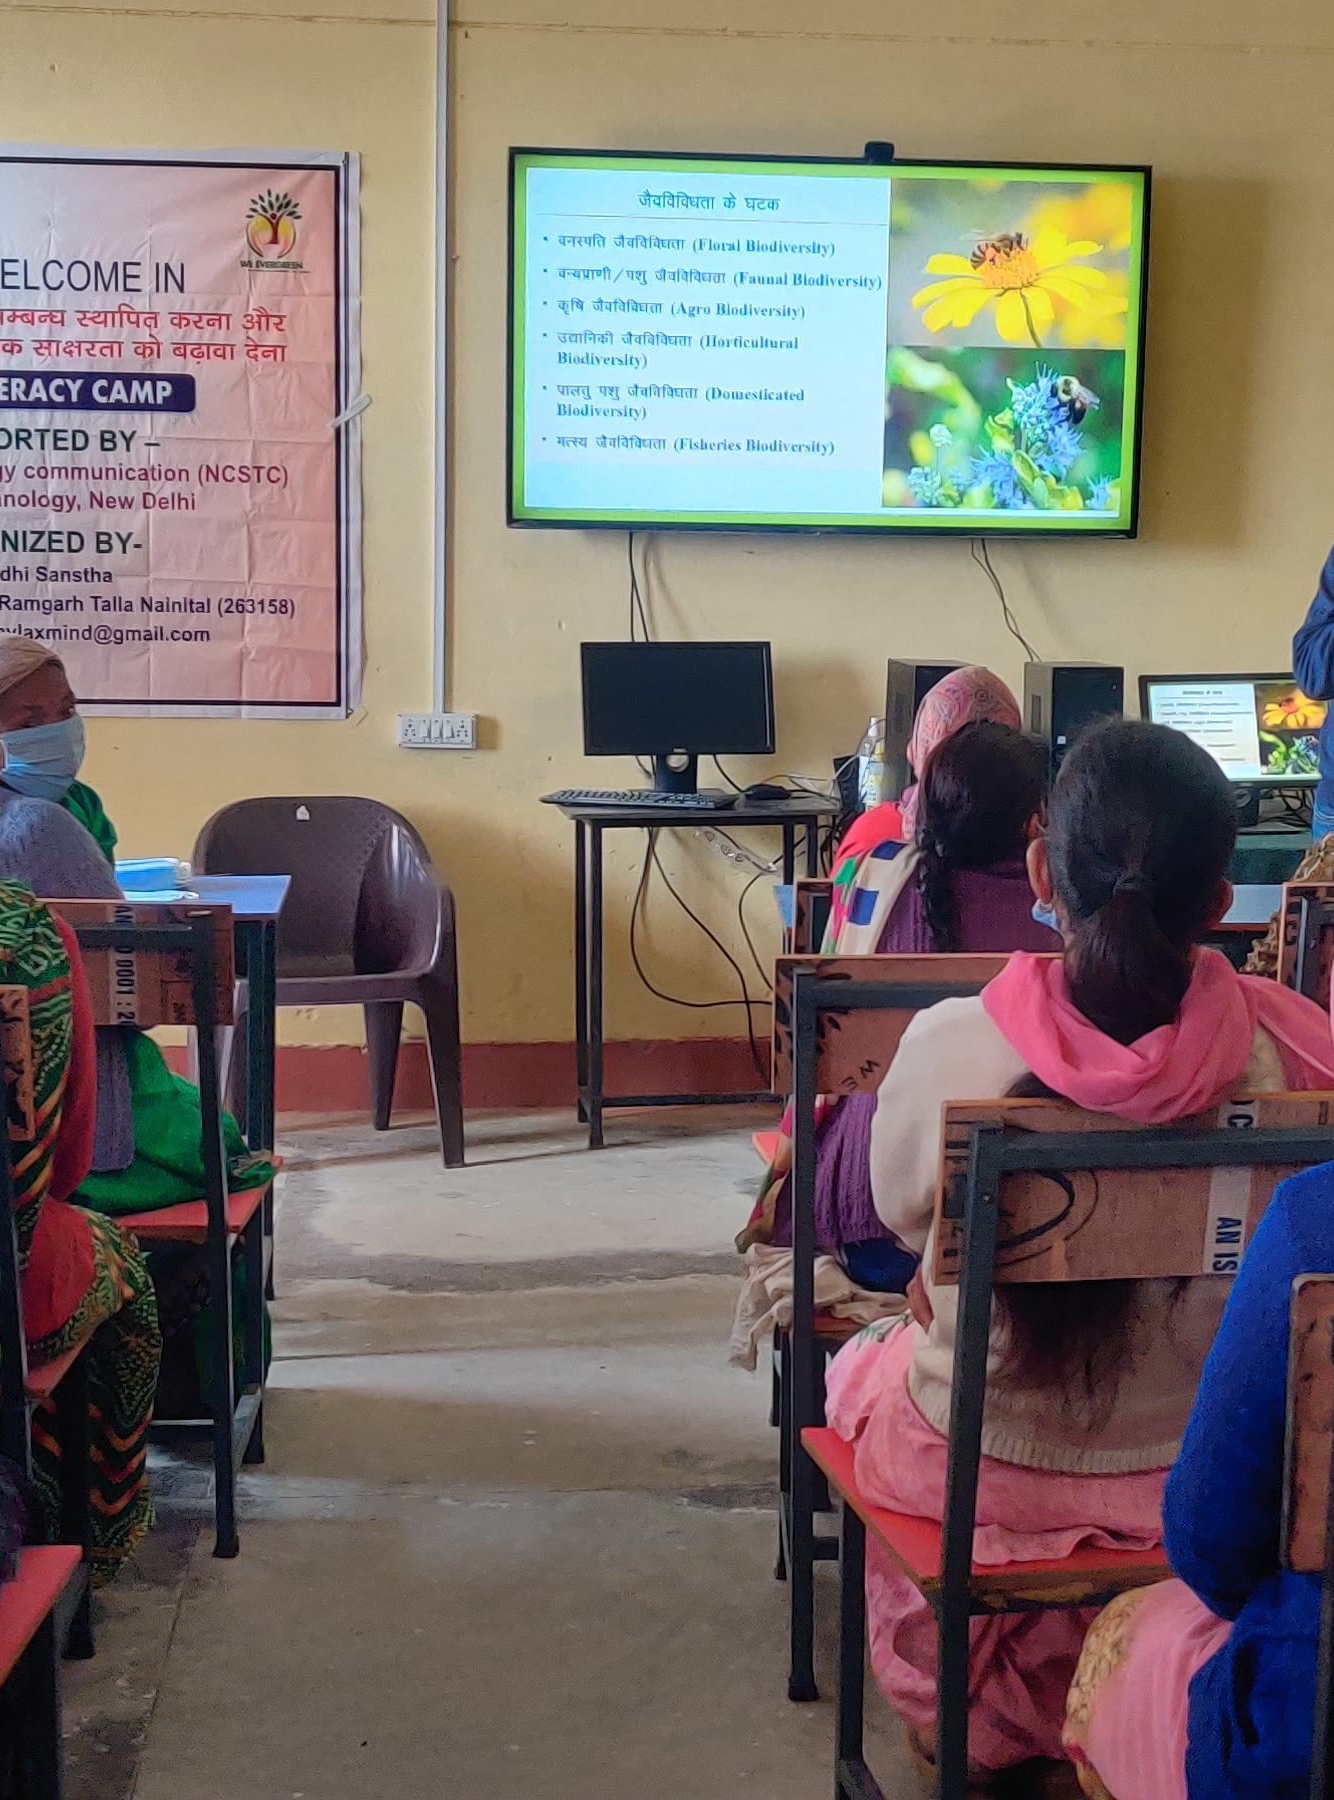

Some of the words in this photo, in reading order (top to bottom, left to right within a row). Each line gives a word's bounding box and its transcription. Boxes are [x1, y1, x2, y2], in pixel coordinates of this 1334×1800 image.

[638, 189, 715, 211] जैवविविधता
[722, 191, 737, 211] के
[744, 197, 781, 212] घटक
[557, 234, 606, 250] वनस्पति
[692, 237, 741, 253] (Floral
[746, 238, 836, 257] Biodiversity)
[155, 262, 185, 294] IN
[733, 271, 788, 288] (Faunal
[792, 272, 882, 292] Biodiversity)
[75, 303, 160, 331] स्थापित
[168, 310, 233, 331] करना
[241, 305, 287, 334] और
[557, 297, 585, 316] कृषि
[670, 302, 711, 319] (Agro
[715, 302, 806, 321] Biodiversity)
[31, 339, 125, 359] साक्षरता
[131, 332, 163, 361] को
[170, 342, 238, 366] बढ़ावा
[244, 336, 288, 363] देना
[699, 335, 799, 351] (Horticultural
[557, 352, 648, 369] Biodiversity)
[91, 379, 173, 404] CAMP
[597, 384, 620, 401] पशु
[705, 387, 805, 403] (Domesticated
[556, 403, 647, 421] Biodiversity)
[100, 430, 137, 453] BY
[673, 438, 742, 453] (Fisheries
[746, 438, 835, 456] Biodiversity)
[24, 461, 190, 483] communication
[198, 463, 289, 489] (NCSTC)
[90, 491, 135, 511] New
[142, 491, 196, 512] Delhi
[95, 531, 143, 554] BY-
[35, 566, 113, 583] Sanstha
[90, 595, 134, 613] Talla
[140, 597, 211, 614] Nainital
[217, 597, 296, 618] (263158)
[1214, 1216, 1242, 1245] AN
